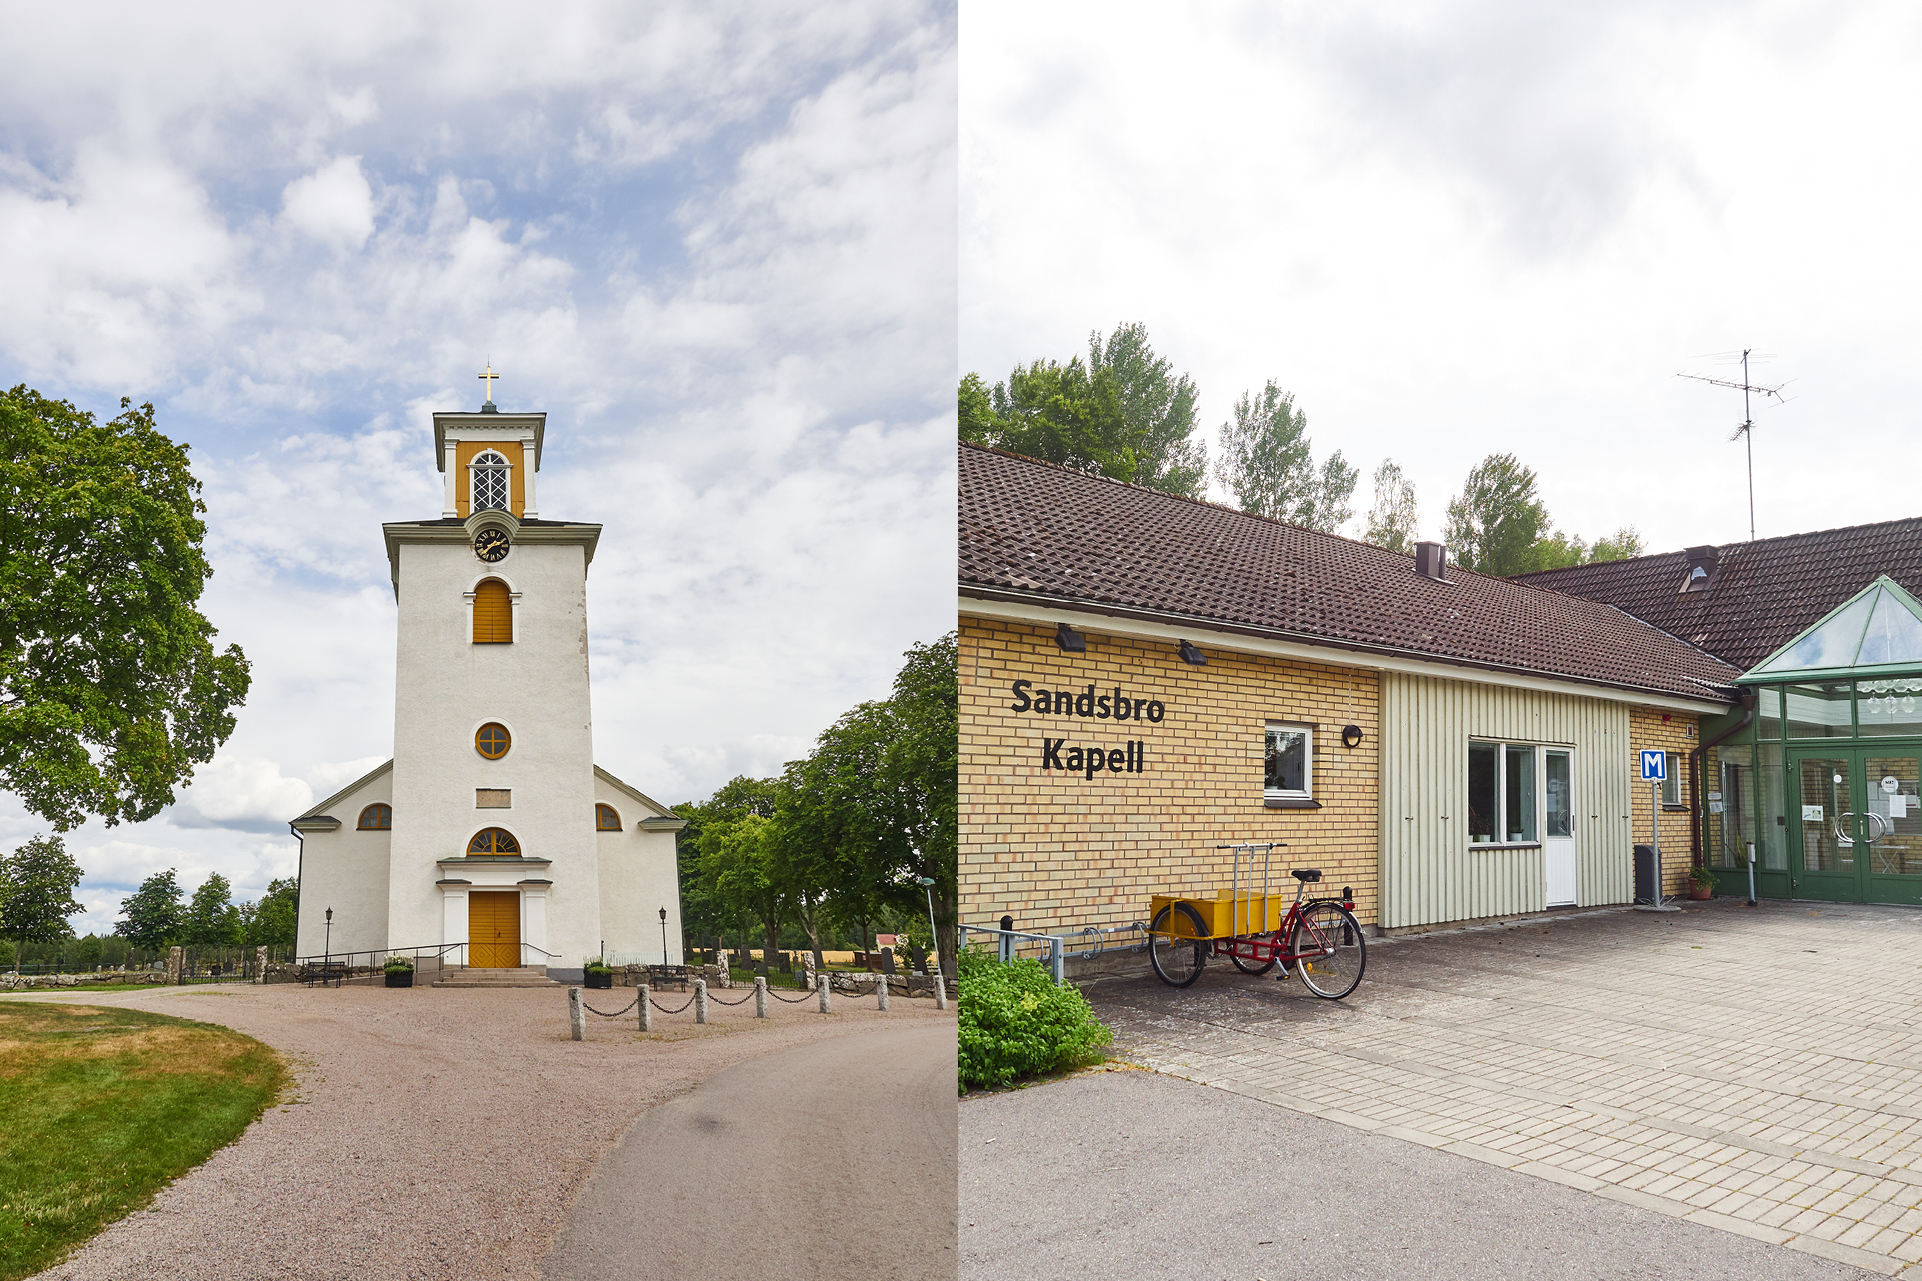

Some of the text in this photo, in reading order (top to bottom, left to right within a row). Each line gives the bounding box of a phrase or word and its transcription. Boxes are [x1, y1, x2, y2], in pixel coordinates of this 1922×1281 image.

[1011, 680, 1165, 723] Sandsbro
[1042, 738, 1144, 781] Kapell
[1644, 753, 1663, 777] M
